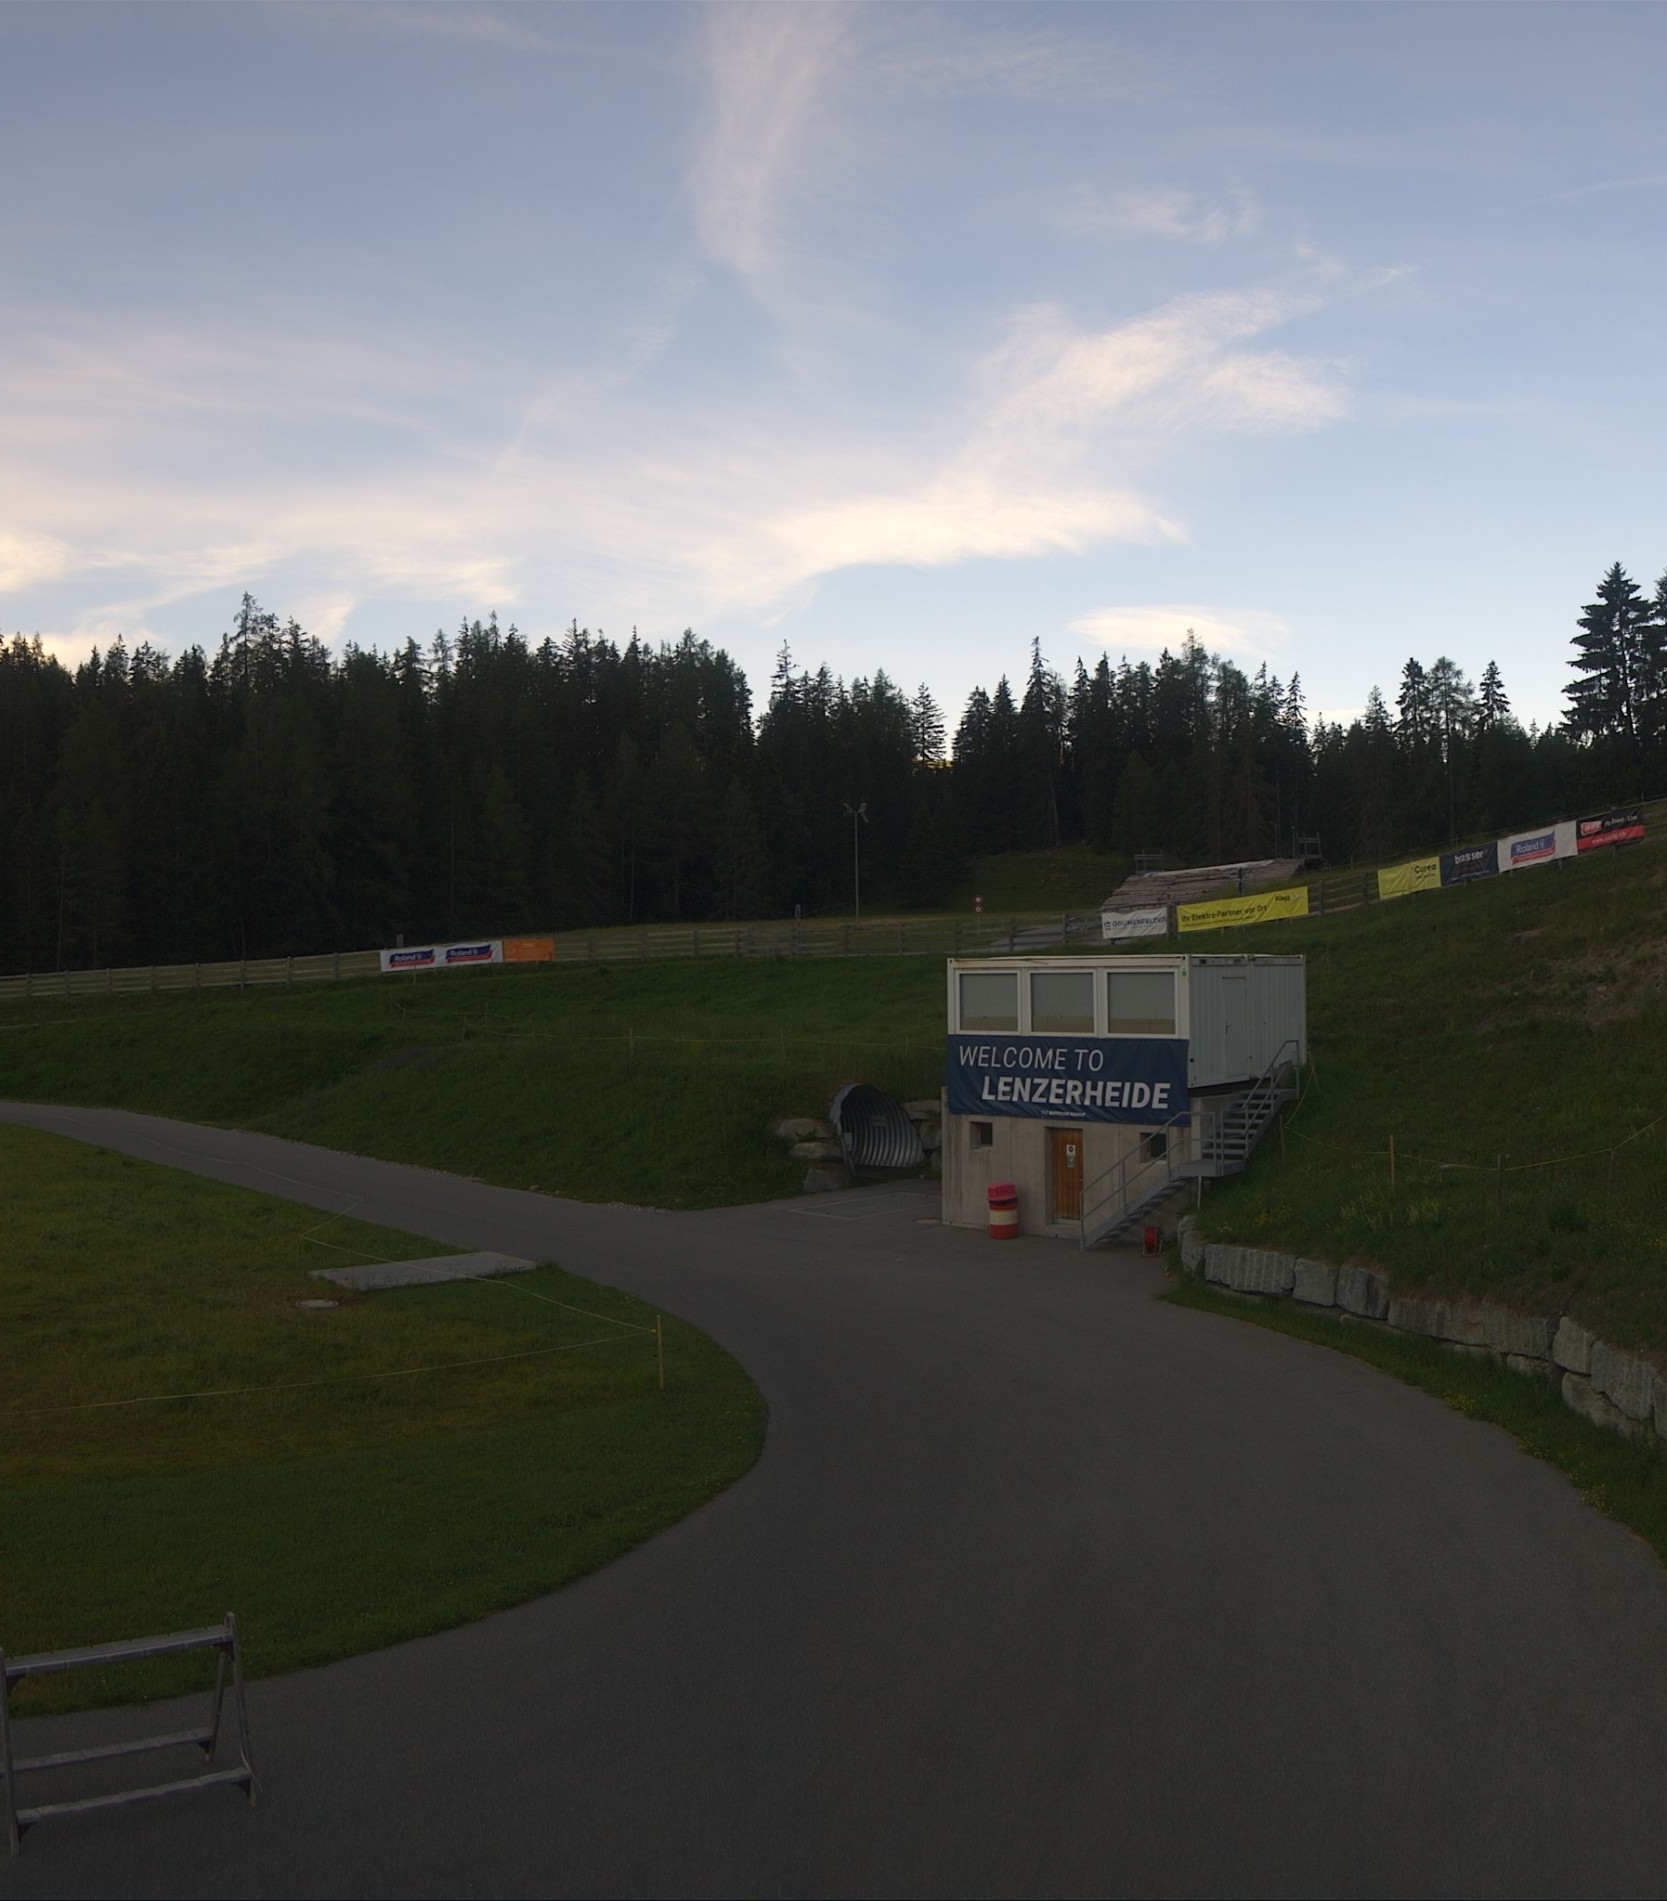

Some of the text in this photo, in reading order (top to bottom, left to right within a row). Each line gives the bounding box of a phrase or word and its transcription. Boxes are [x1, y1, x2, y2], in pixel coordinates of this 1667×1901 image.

[1181, 914, 1191, 923] Ihr
[1192, 908, 1243, 921] Elektro-Partner
[1244, 907, 1255, 915] vor
[1256, 904, 1268, 913] Ort
[394, 953, 417, 962] Roland
[450, 948, 473, 957] Roland
[959, 1044, 1104, 1072] WELCOME TO
[981, 1075, 1172, 1110] LENZERHEIDE
